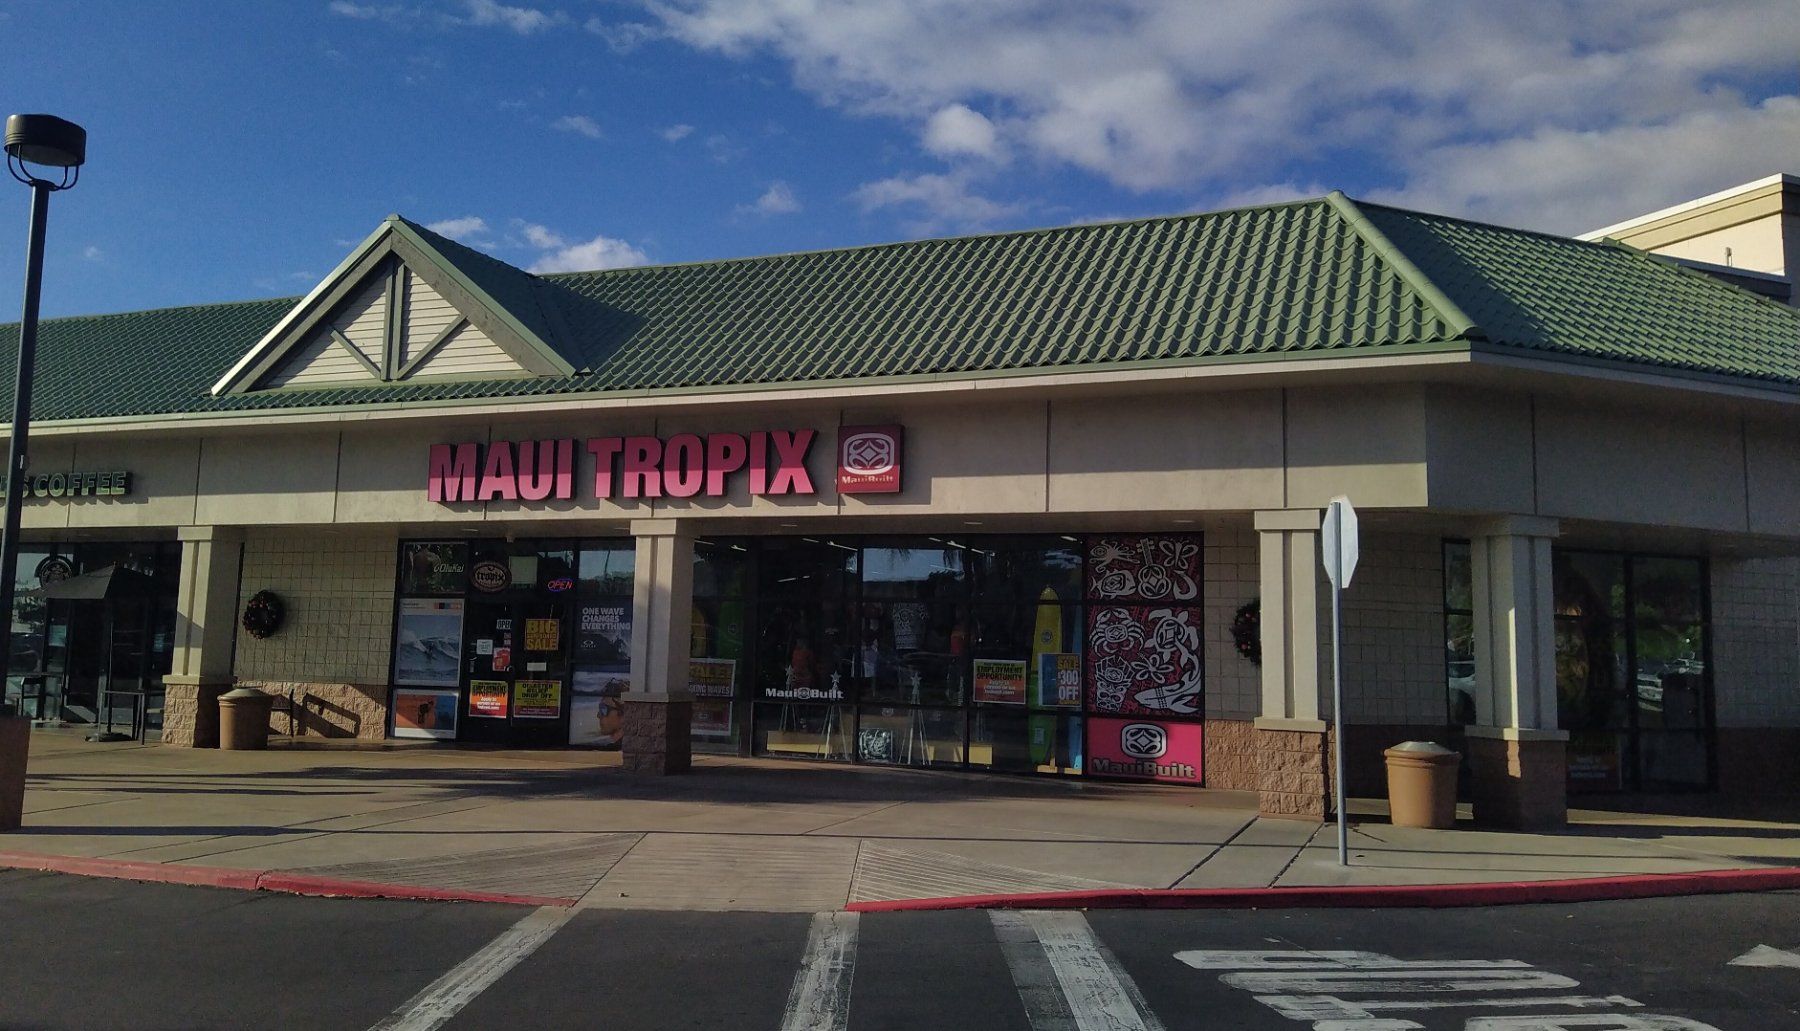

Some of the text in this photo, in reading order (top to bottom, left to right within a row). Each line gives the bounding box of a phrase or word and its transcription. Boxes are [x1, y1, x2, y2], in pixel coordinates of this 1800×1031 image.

[429, 429, 820, 502] MAUI TROPIX
[33, 470, 128, 498] COFFEE
[547, 580, 573, 590] OPEN
[582, 607, 625, 616] ONE WAVE
[582, 615, 620, 623] CHANGES
[527, 620, 557, 633] BIG
[581, 622, 631, 630] EVERYTHING
[527, 639, 557, 650] SALE
[765, 688, 845, 699] Maui Built
[1058, 686, 1079, 700] OFF
[1092, 758, 1196, 779] MauiBuilt
